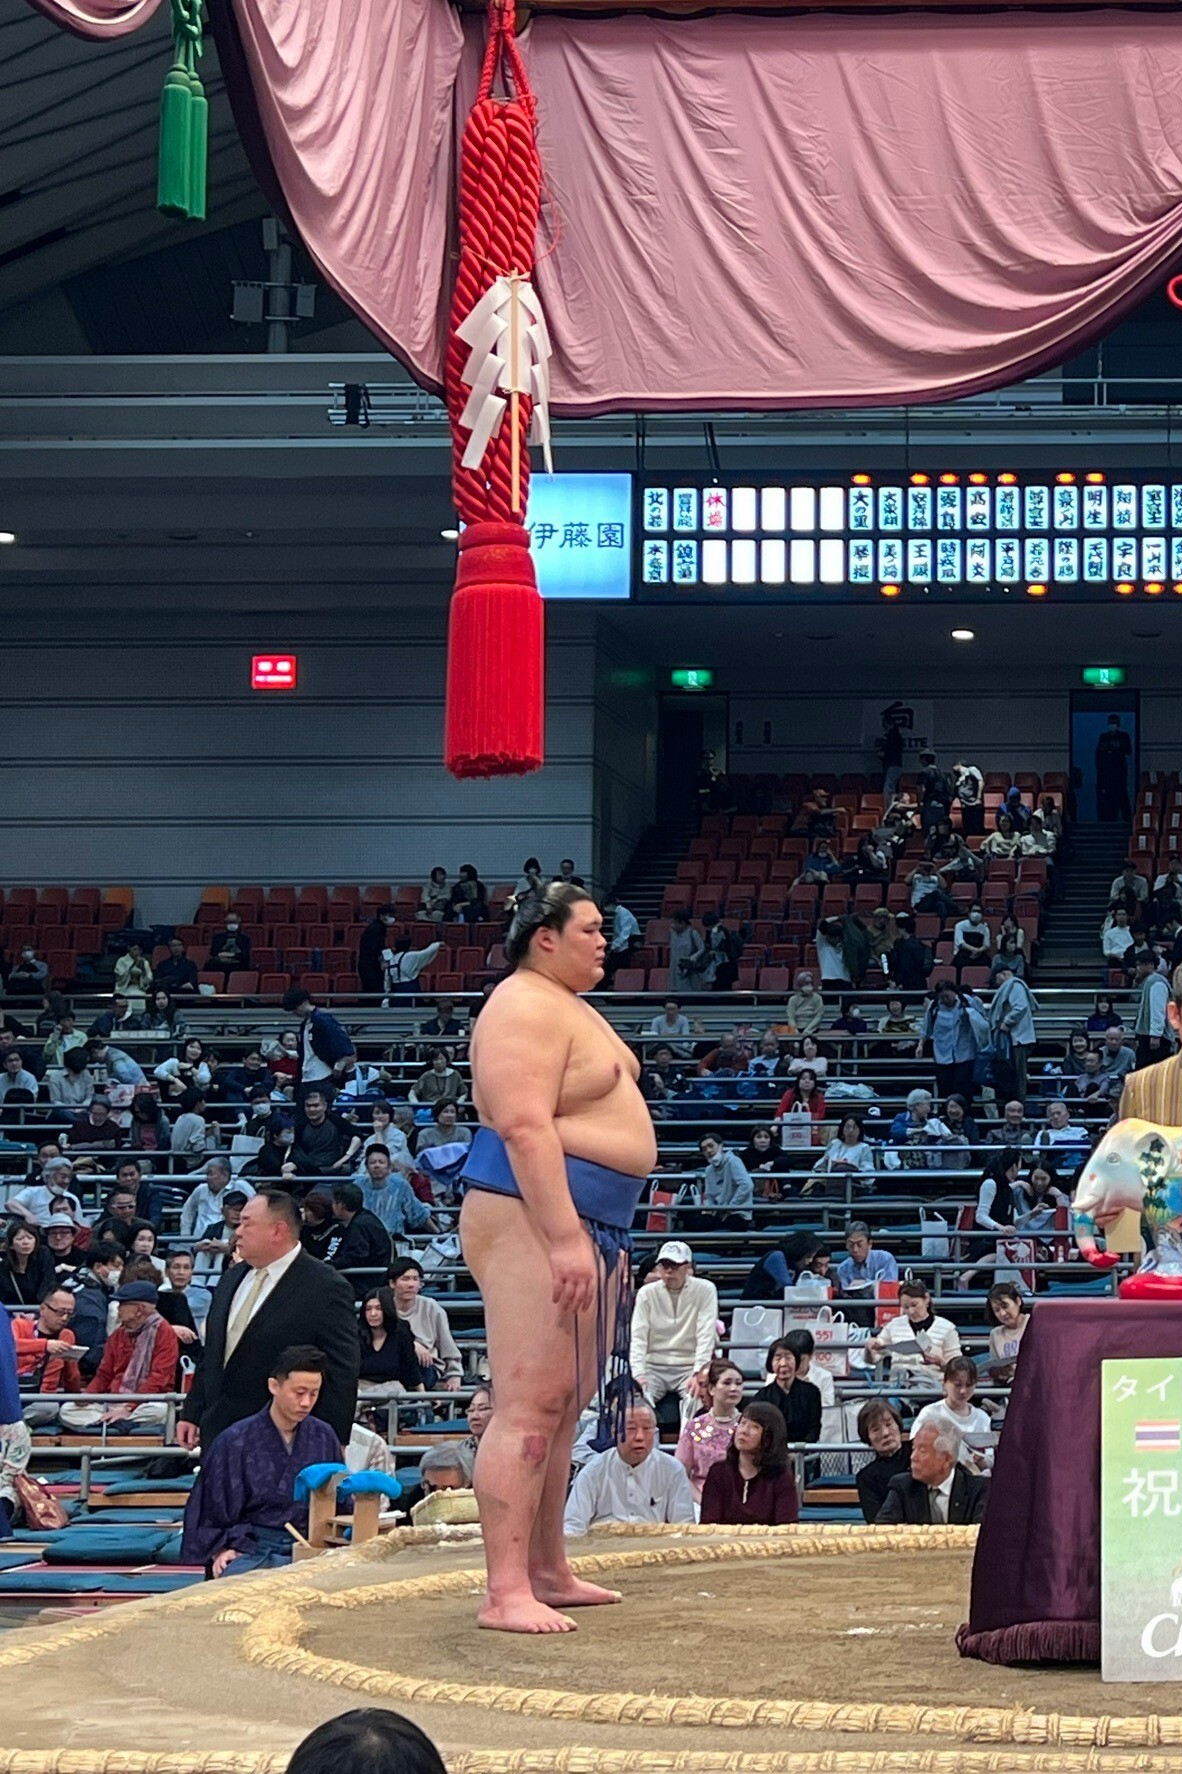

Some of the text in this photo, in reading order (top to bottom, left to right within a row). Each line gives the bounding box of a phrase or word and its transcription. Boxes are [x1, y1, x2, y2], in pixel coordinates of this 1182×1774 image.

[853, 491, 869, 528] 大の里
[1087, 489, 1104, 525] 明生
[1116, 489, 1132, 526] 翔猿
[528, 522, 625, 549] 伊藤園
[969, 541, 987, 578] 阿炎
[1116, 540, 1134, 578] 宇良
[1146, 544, 1163, 574] 一山本
